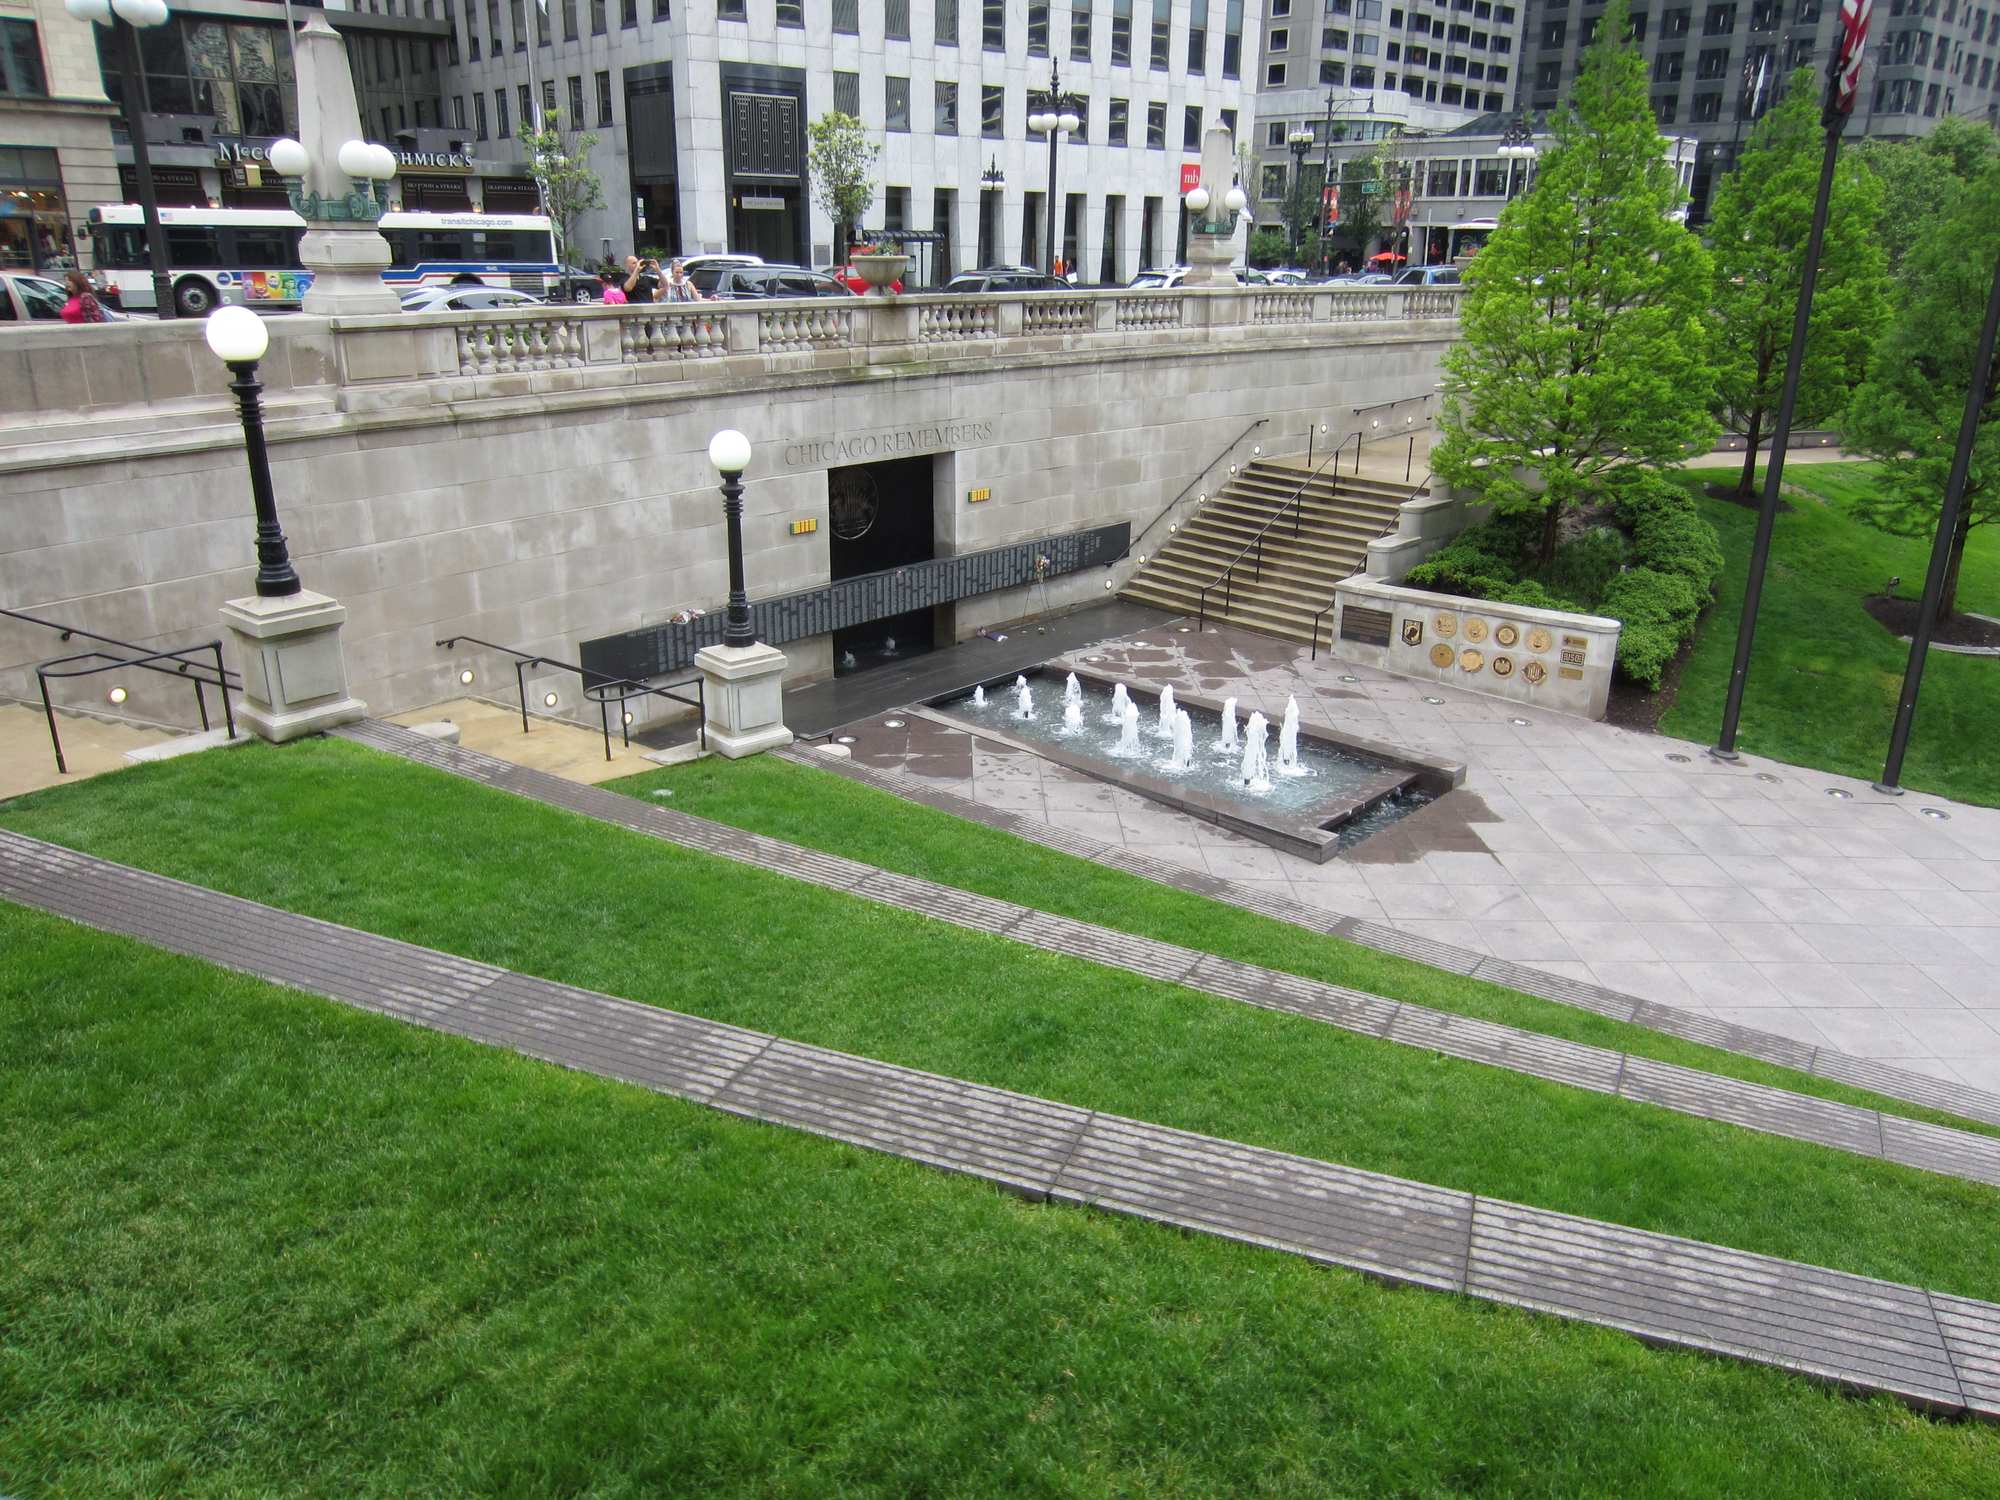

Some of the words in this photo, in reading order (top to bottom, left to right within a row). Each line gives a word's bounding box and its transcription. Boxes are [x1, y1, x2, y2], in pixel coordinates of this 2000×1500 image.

[441, 216, 513, 227] transitchicago.com
[784, 435, 878, 466] CHICAGO
[882, 422, 993, 453] REMEMBERS
